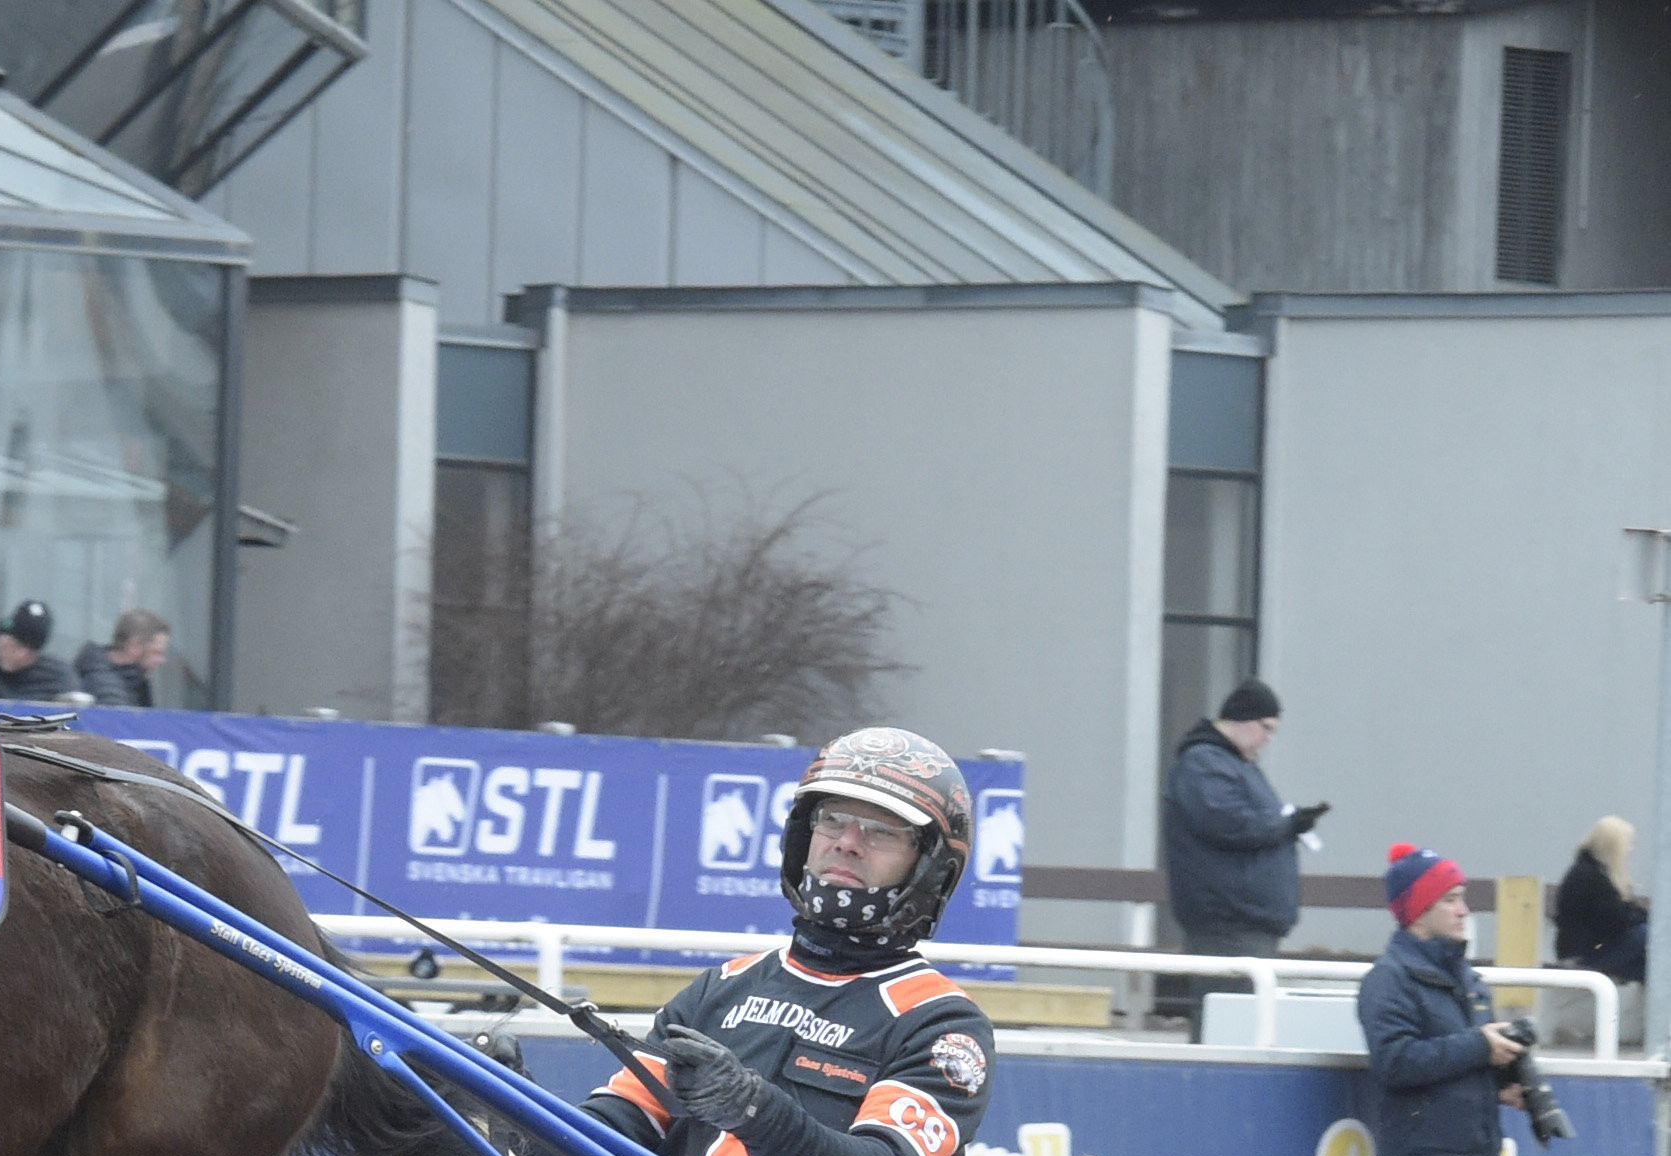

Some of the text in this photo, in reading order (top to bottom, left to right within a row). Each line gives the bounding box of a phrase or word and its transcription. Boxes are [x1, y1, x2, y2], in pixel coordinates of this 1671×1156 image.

[183, 748, 322, 845] STL
[475, 765, 617, 861] STL
[406, 860, 501, 884] SVENSKA
[210, 919, 240, 945] Stall
[889, 1096, 948, 1153] CS
